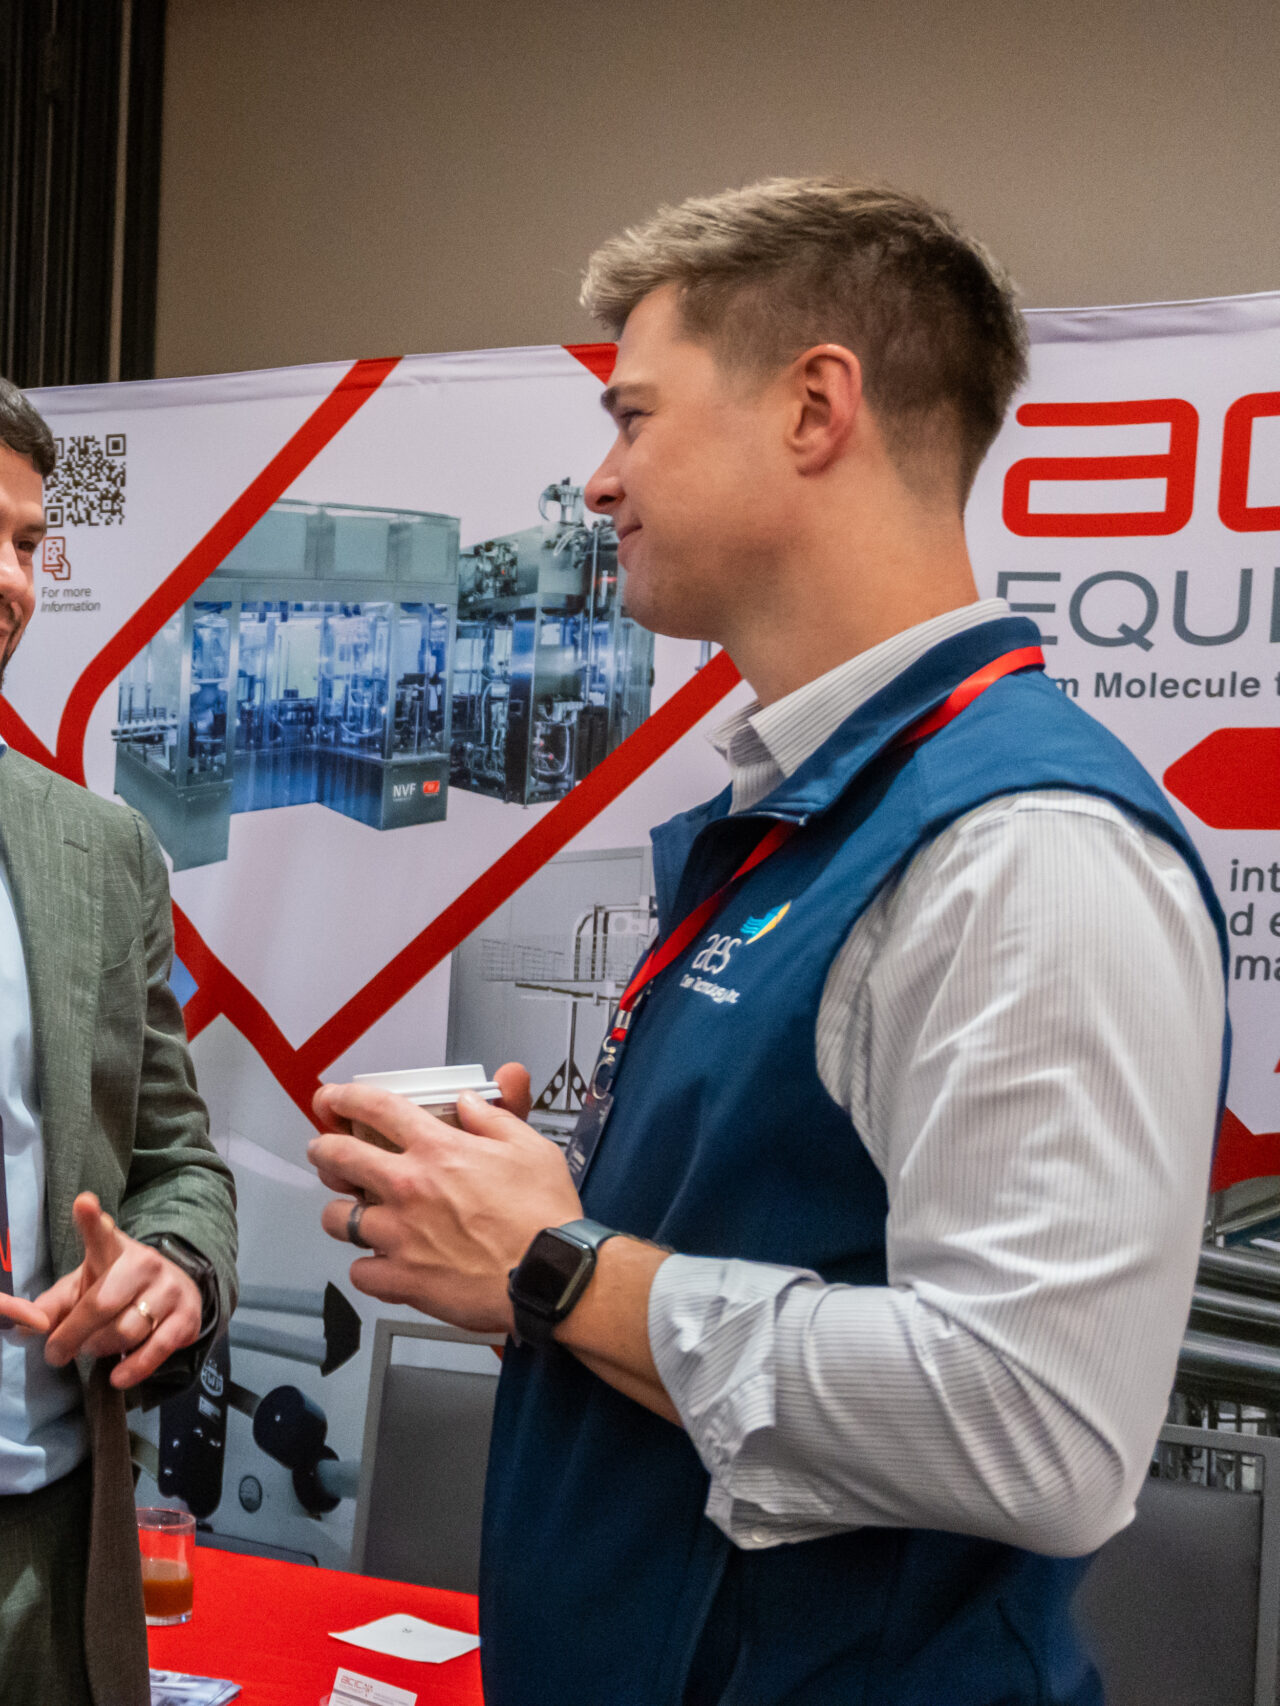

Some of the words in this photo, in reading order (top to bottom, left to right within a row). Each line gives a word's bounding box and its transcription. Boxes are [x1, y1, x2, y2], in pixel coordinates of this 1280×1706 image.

[42, 586, 59, 598] For
[63, 588, 91, 598] more
[1094, 671, 1261, 698] Molecule
[393, 782, 417, 798] NVF
